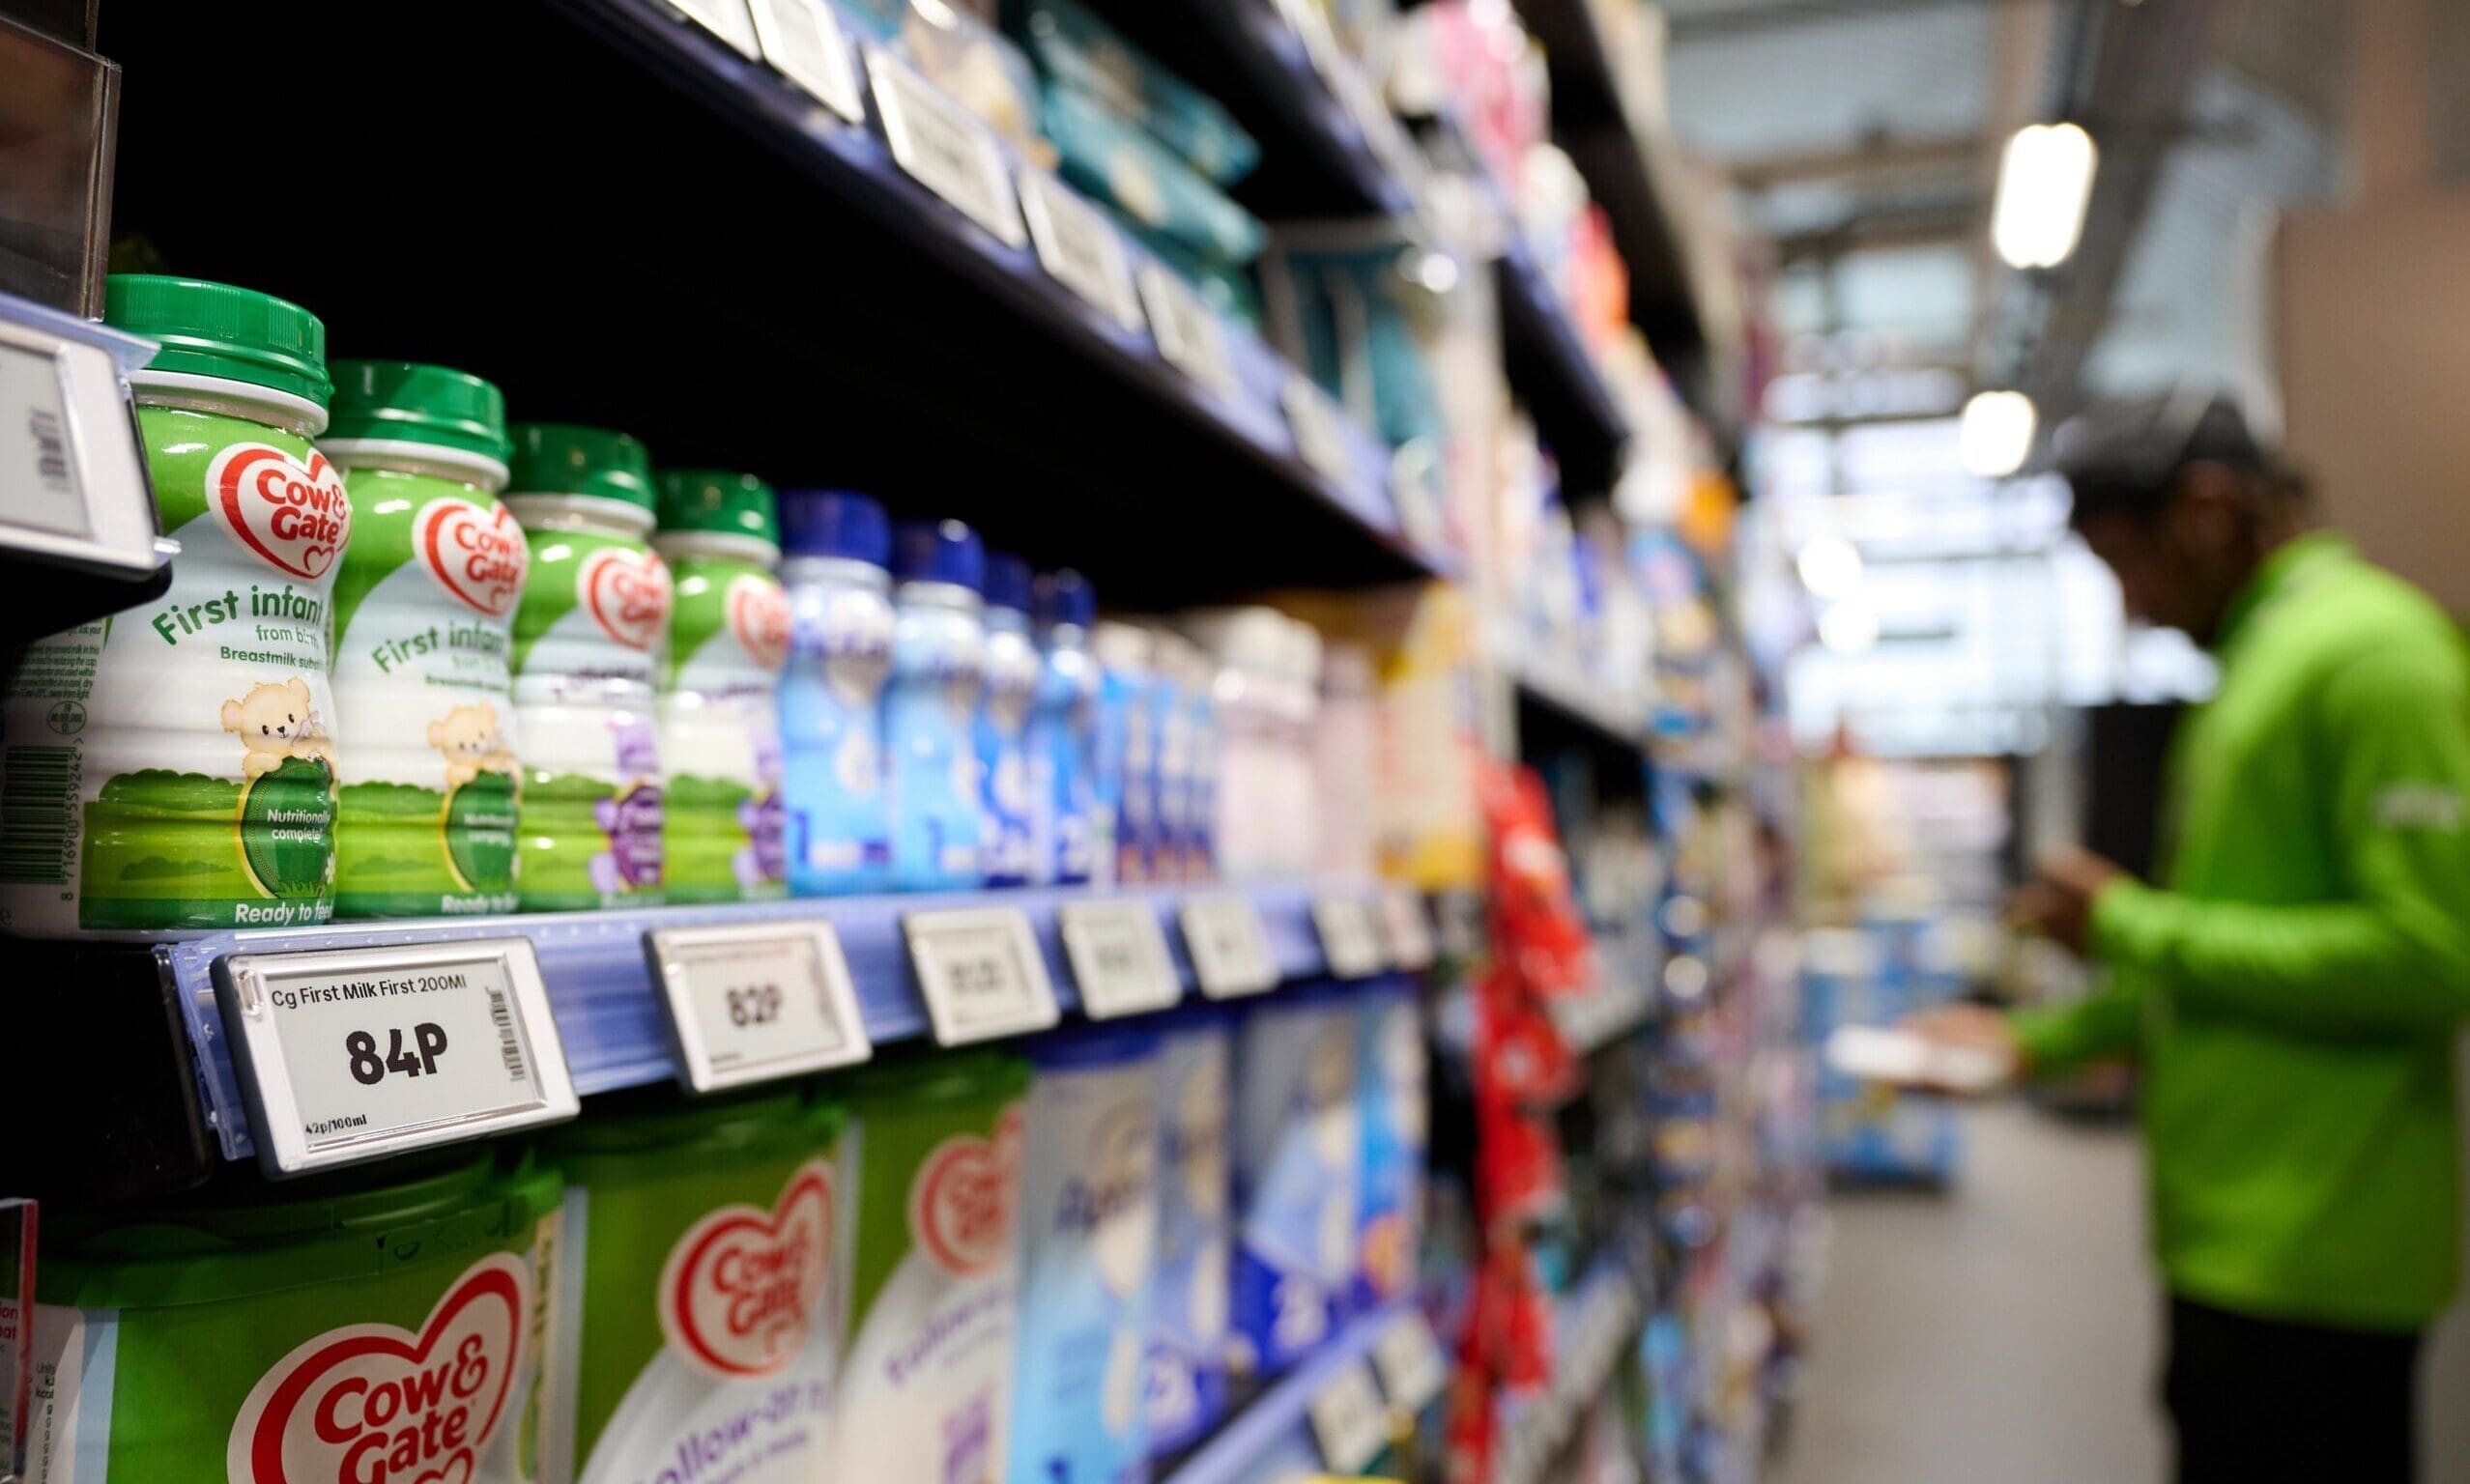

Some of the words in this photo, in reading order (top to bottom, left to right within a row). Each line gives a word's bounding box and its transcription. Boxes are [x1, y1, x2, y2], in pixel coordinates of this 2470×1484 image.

[271, 505, 339, 545] Gate
[152, 590, 239, 645] First
[255, 624, 292, 642] from
[220, 645, 297, 668] Breastmilk
[371, 626, 439, 673] First
[235, 901, 295, 927] Ready
[299, 902, 312, 922] to
[272, 989, 297, 1010] Cg
[300, 985, 341, 1006] First
[343, 981, 378, 1002] Milk
[380, 978, 416, 997] First
[346, 1022, 448, 1085] 84P
[304, 1114, 368, 1135] 42p/100ml
[339, 1405, 469, 1484] Gate
